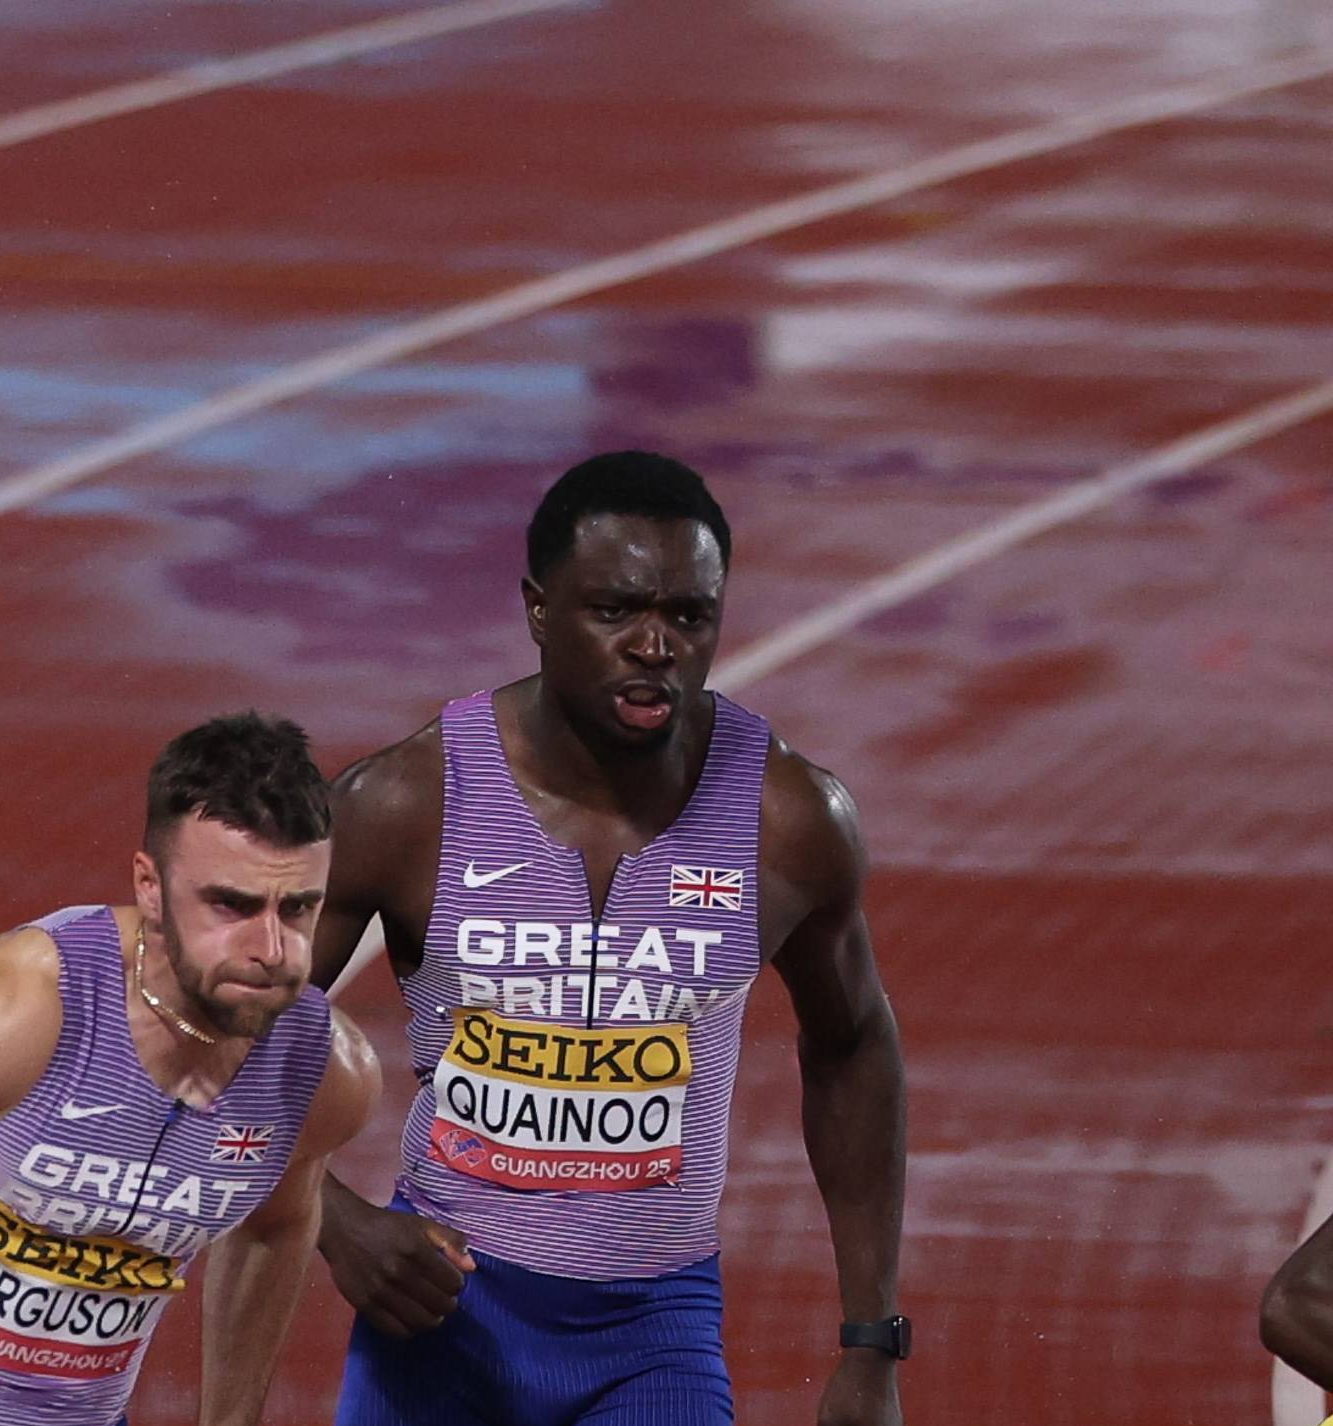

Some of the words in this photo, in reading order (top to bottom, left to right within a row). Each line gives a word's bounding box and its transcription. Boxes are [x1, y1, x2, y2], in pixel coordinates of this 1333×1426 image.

[457, 919, 722, 976] GREAT
[459, 973, 720, 1020] BRITAIN
[453, 1015, 680, 1083] SEIKO
[446, 1075, 670, 1144] QUAINOO
[19, 1143, 250, 1219] GREAT
[491, 1153, 640, 1180] GUANGZHOU
[645, 1159, 671, 1178] 25
